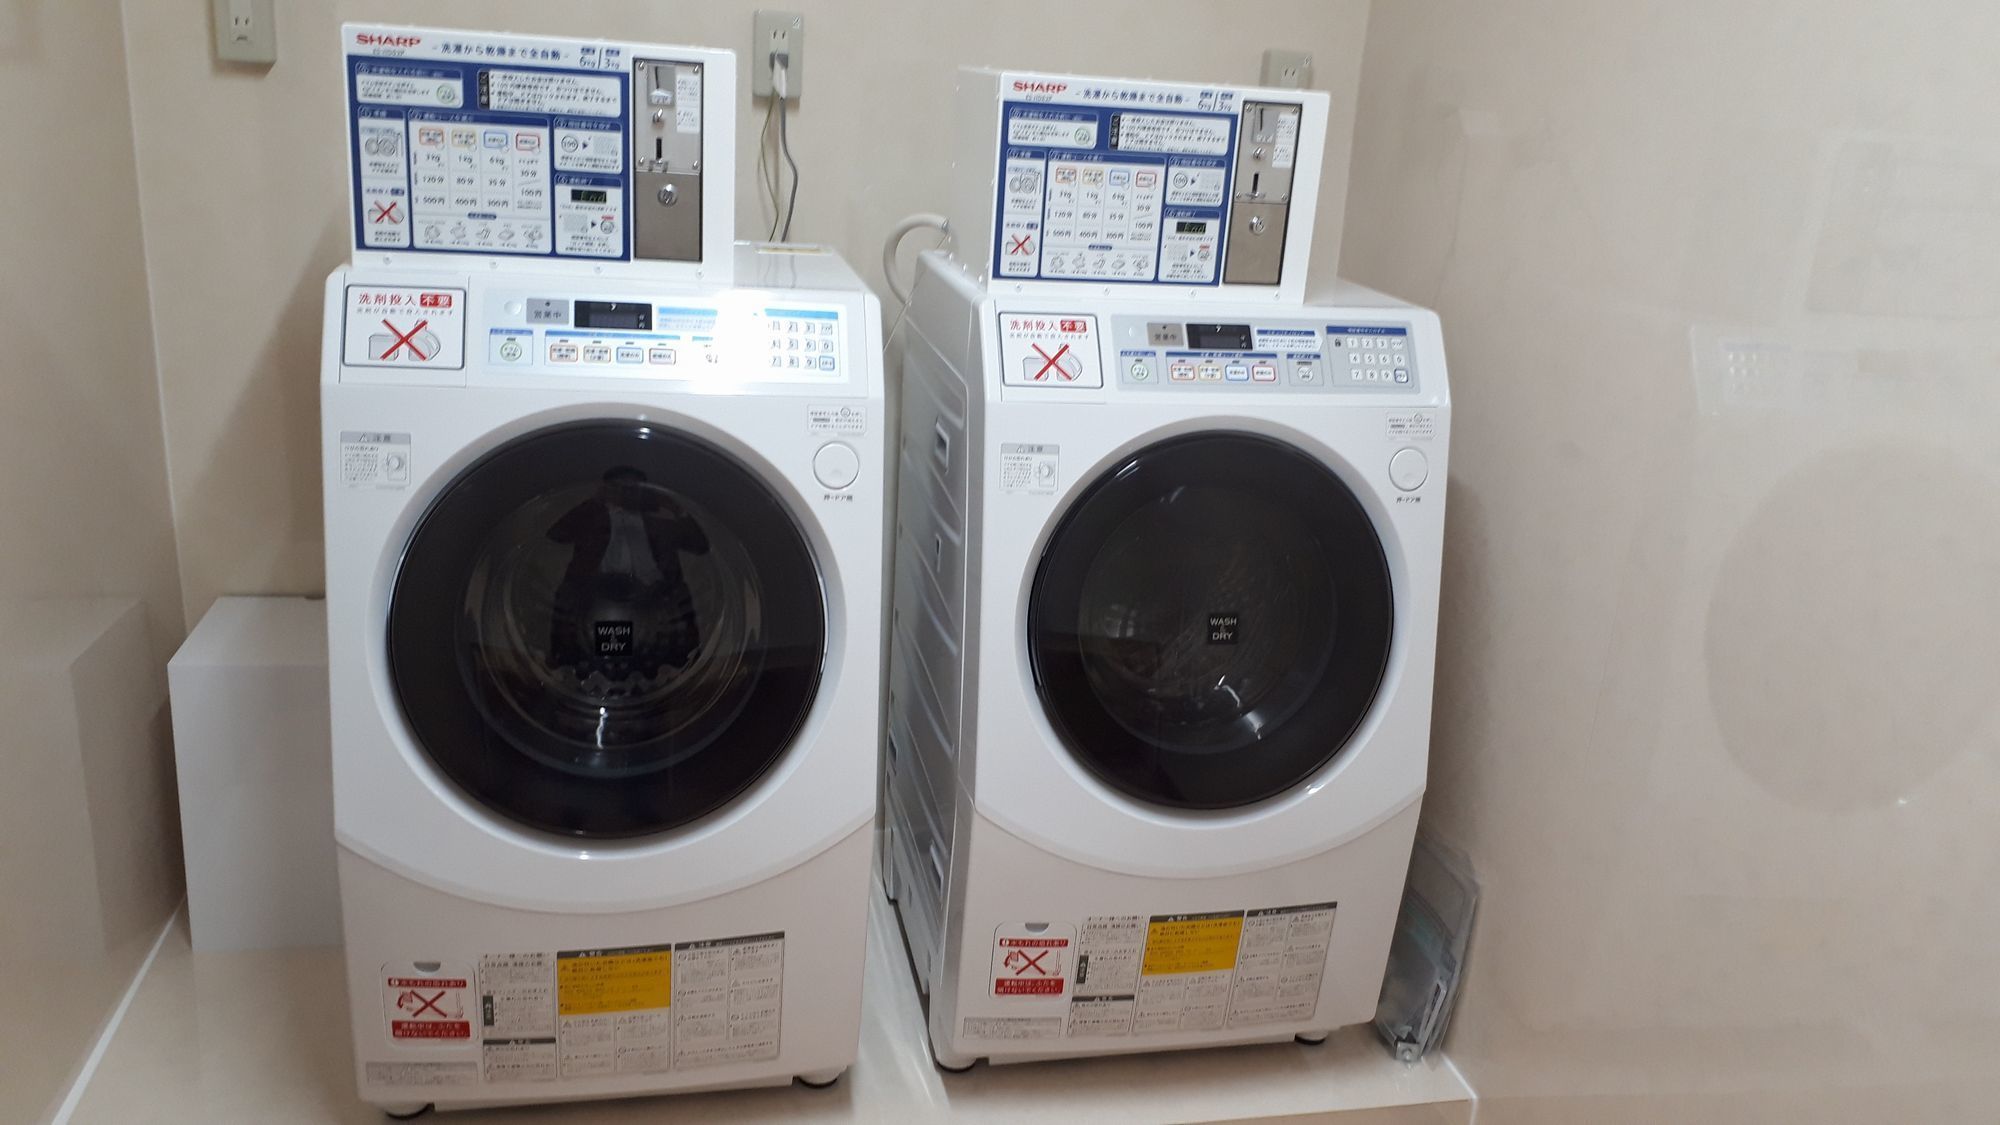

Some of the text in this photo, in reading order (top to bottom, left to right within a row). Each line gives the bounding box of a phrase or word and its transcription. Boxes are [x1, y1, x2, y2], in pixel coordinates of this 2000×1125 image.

[356, 32, 421, 48] SHARP
[1013, 80, 1067, 94] SHARP
[358, 293, 450, 307] 洗剤投入 不要
[534, 309, 562, 320] 営業中
[1010, 320, 1058, 332] 洗剤投入
[1210, 617, 1237, 626] WASH
[597, 626, 631, 636] WASH
[1212, 632, 1233, 640] DRY
[601, 642, 626, 651] DRY
